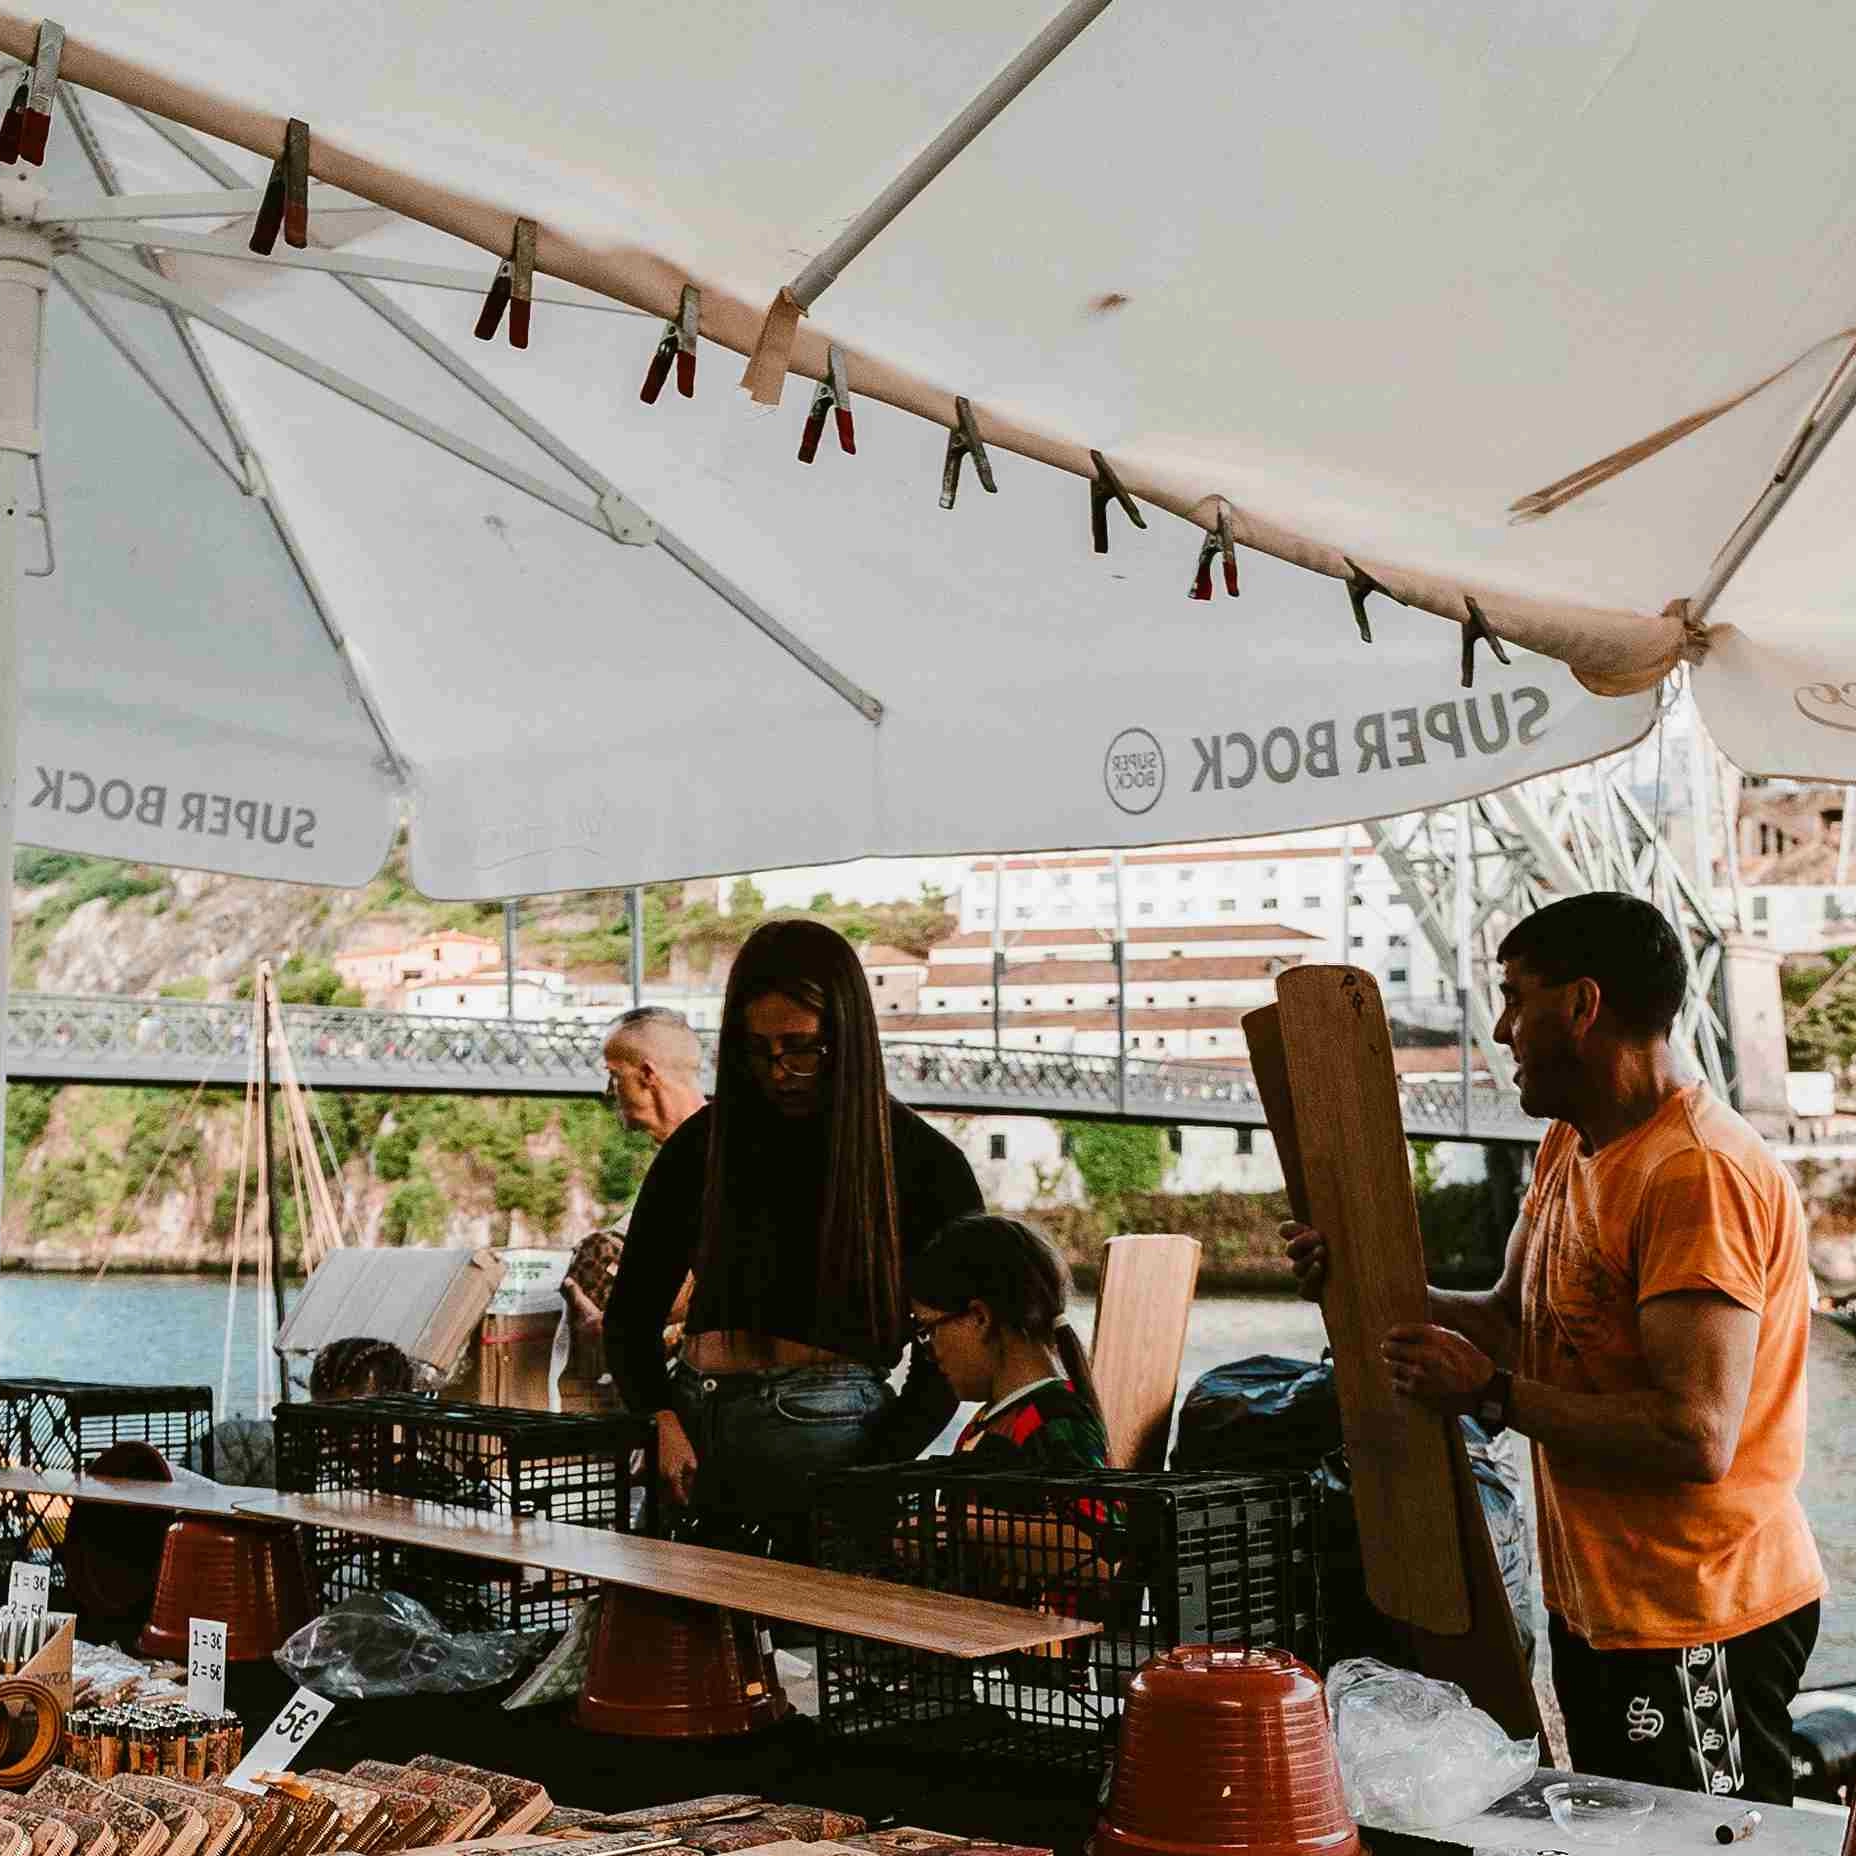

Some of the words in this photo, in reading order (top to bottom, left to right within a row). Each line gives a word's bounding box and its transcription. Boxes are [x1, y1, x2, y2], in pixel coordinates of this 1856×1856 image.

[193, 1630, 200, 1647] 1
[210, 1632, 223, 1651] 3€
[192, 1660, 199, 1677] 2
[209, 1663, 223, 1682] 5€
[274, 1700, 320, 1744] 5€
